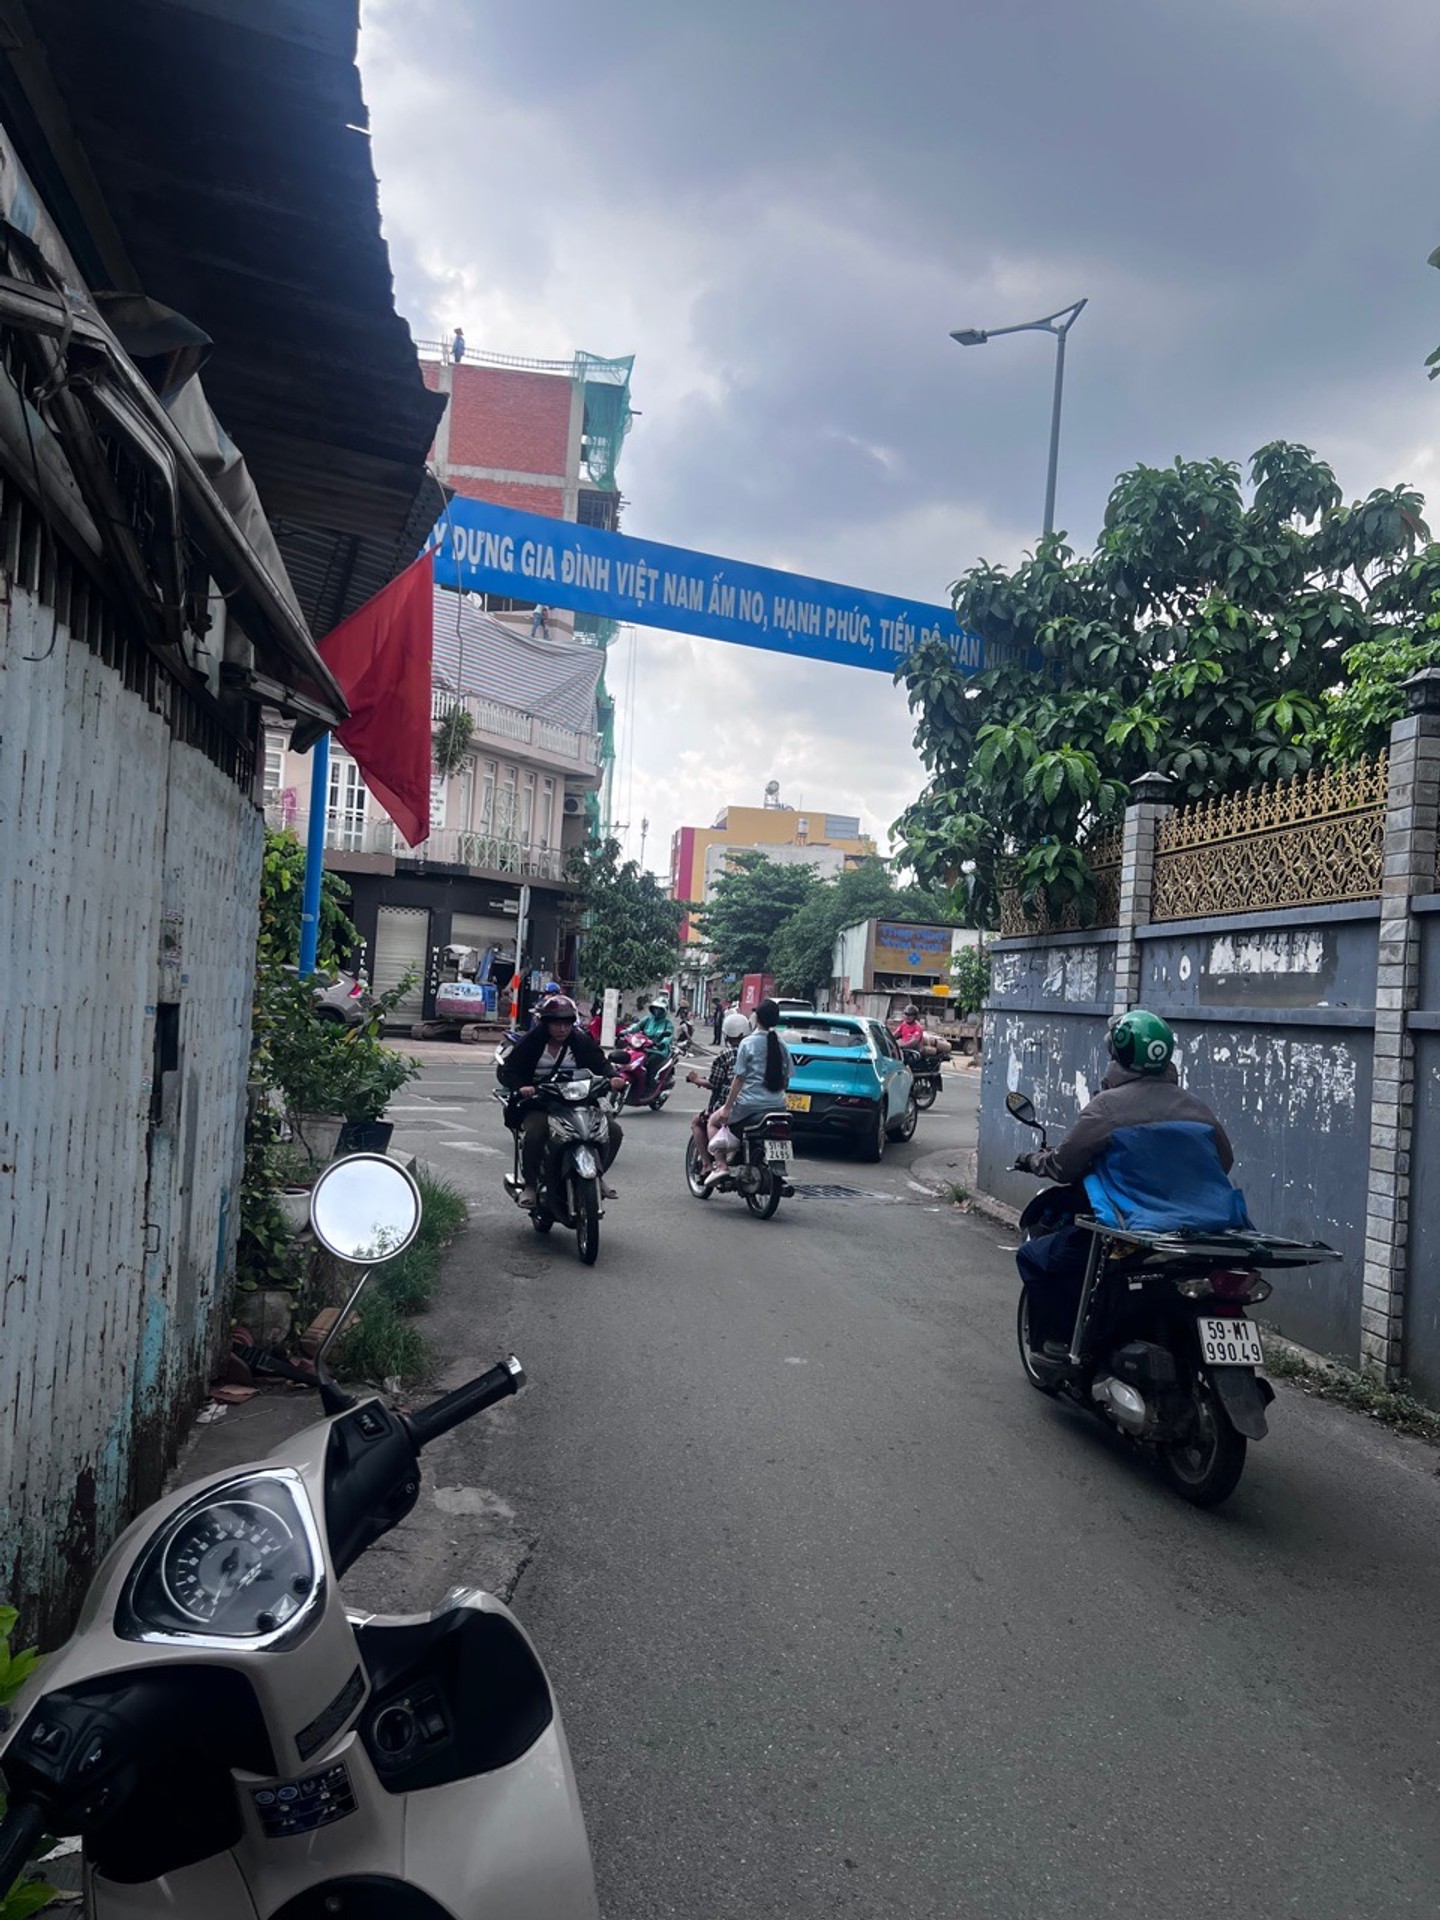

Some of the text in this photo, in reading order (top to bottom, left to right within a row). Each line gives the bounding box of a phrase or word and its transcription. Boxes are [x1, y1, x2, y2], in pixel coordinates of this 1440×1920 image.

[423, 522, 448, 557] Y
[452, 525, 514, 574] DỰNG
[521, 540, 556, 582] GIA
[561, 543, 610, 592] ĐÌNH
[616, 558, 659, 607] VIỆT
[664, 573, 703, 612] NAM
[708, 571, 736, 618] ẤM
[739, 588, 768, 632] NO,
[773, 595, 821, 639] HẠNH
[825, 606, 874, 653] PHÚC,
[879, 611, 915, 654] TIẾN
[1206, 1342, 1261, 1362] 990.49
